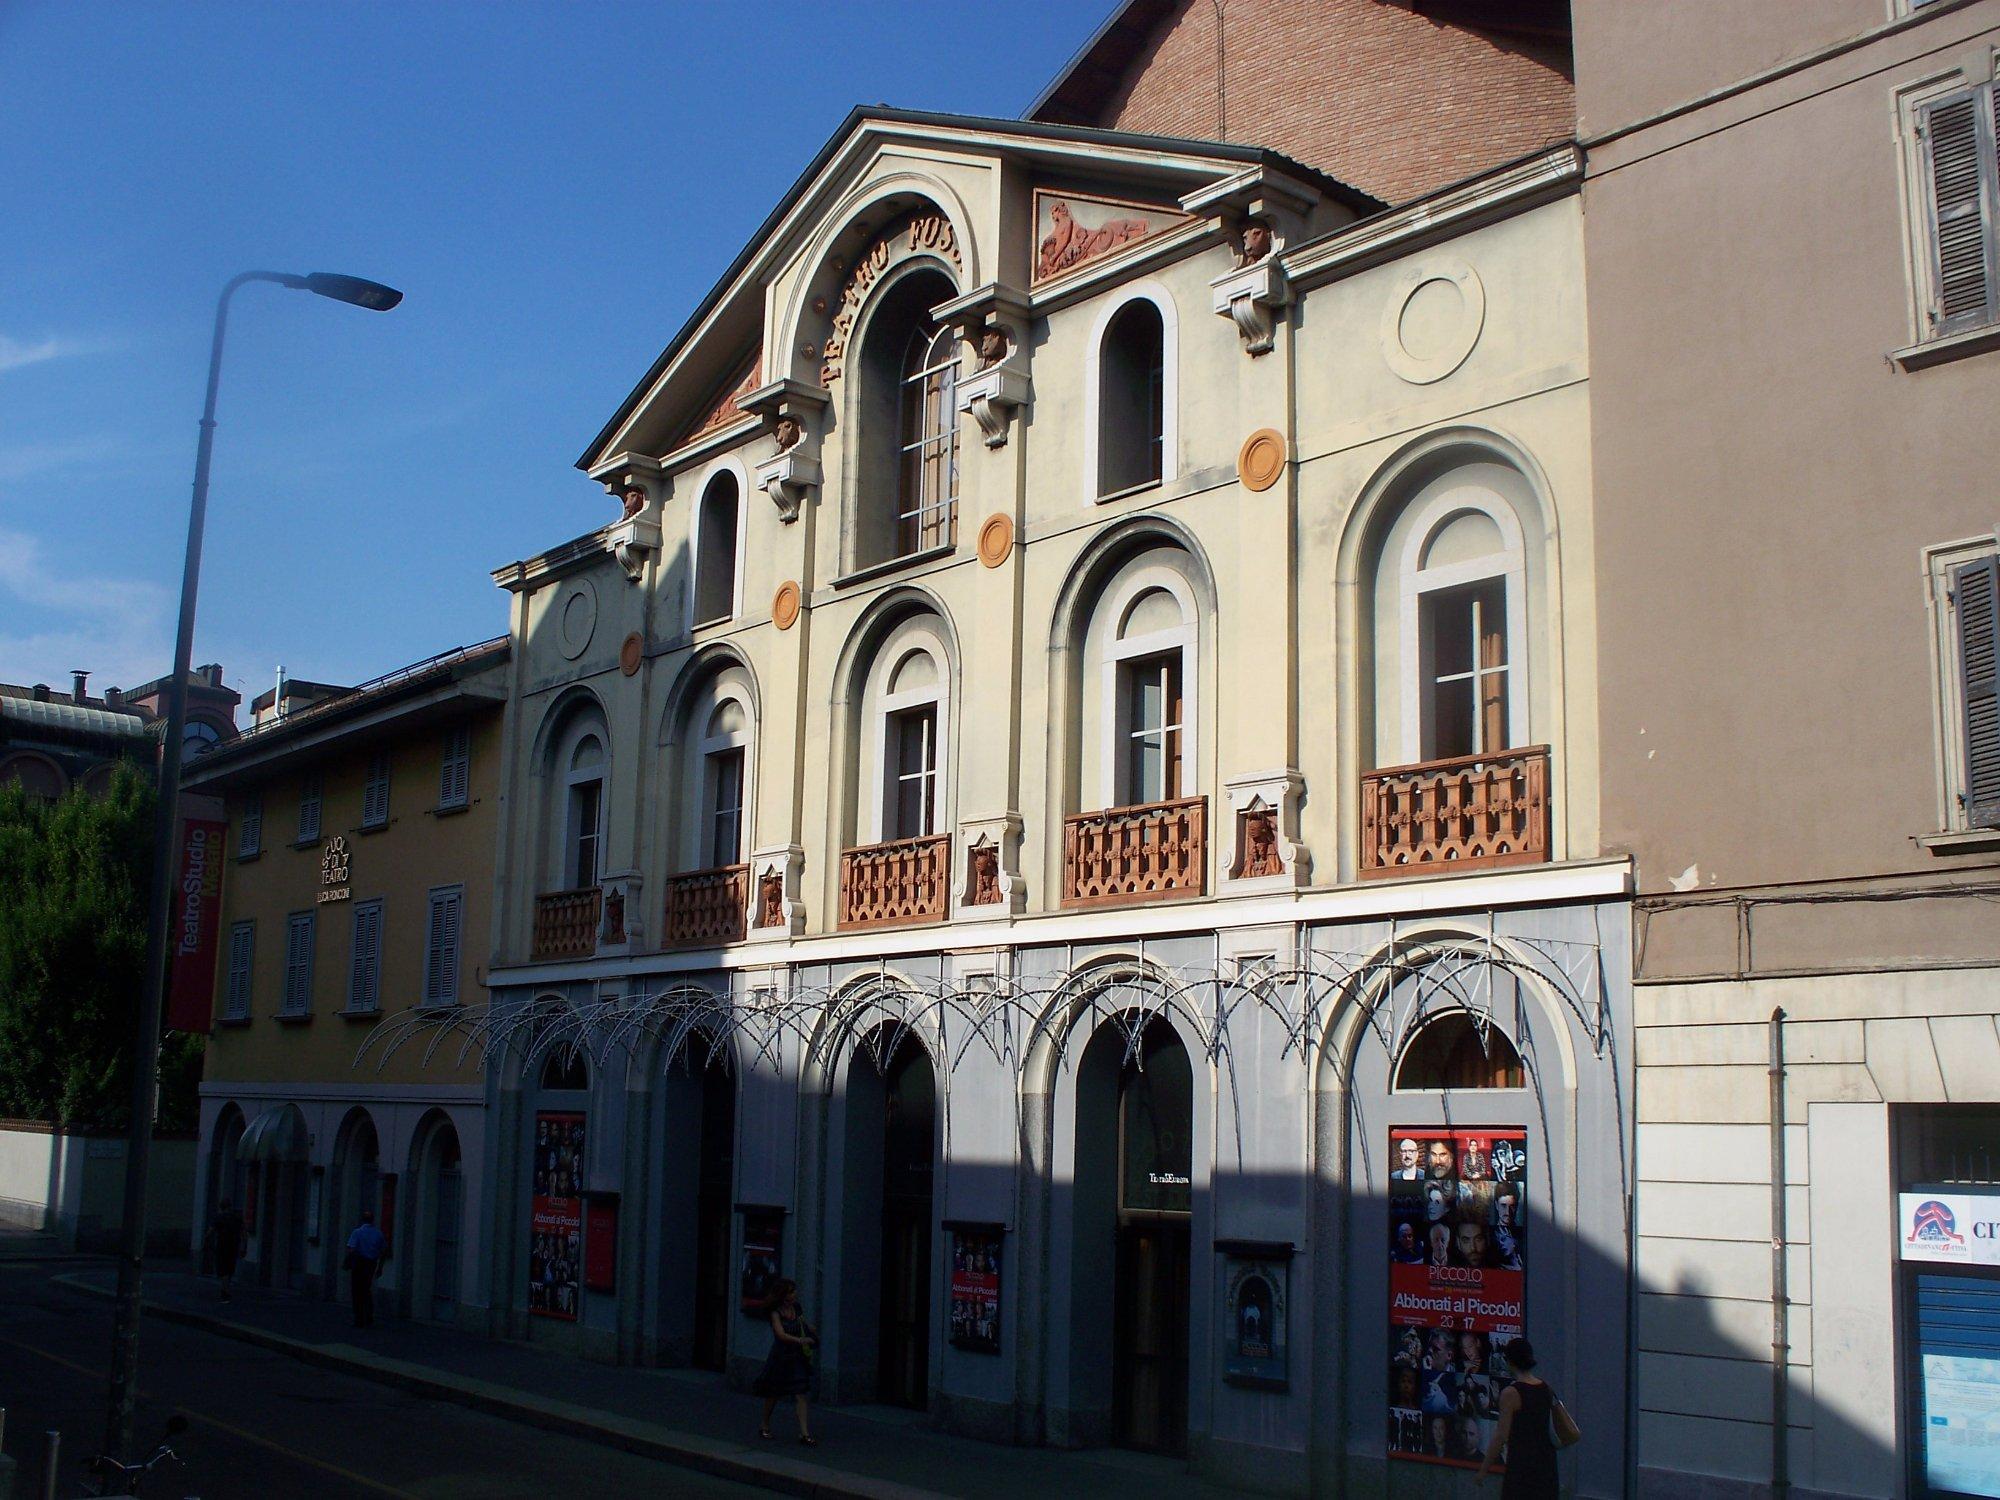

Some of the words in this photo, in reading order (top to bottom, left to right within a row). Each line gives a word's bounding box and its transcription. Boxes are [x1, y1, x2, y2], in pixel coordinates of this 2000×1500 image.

[820, 240, 889, 389] TEATRO
[321, 866, 349, 885] TEATRO
[178, 828, 207, 957] TeatroStudio
[1393, 1292, 1451, 1312] Abbonati
[1453, 1298, 1465, 1313] al
[1468, 1298, 1521, 1317] Piccolo!
[1463, 1316, 1475, 1329] 17
